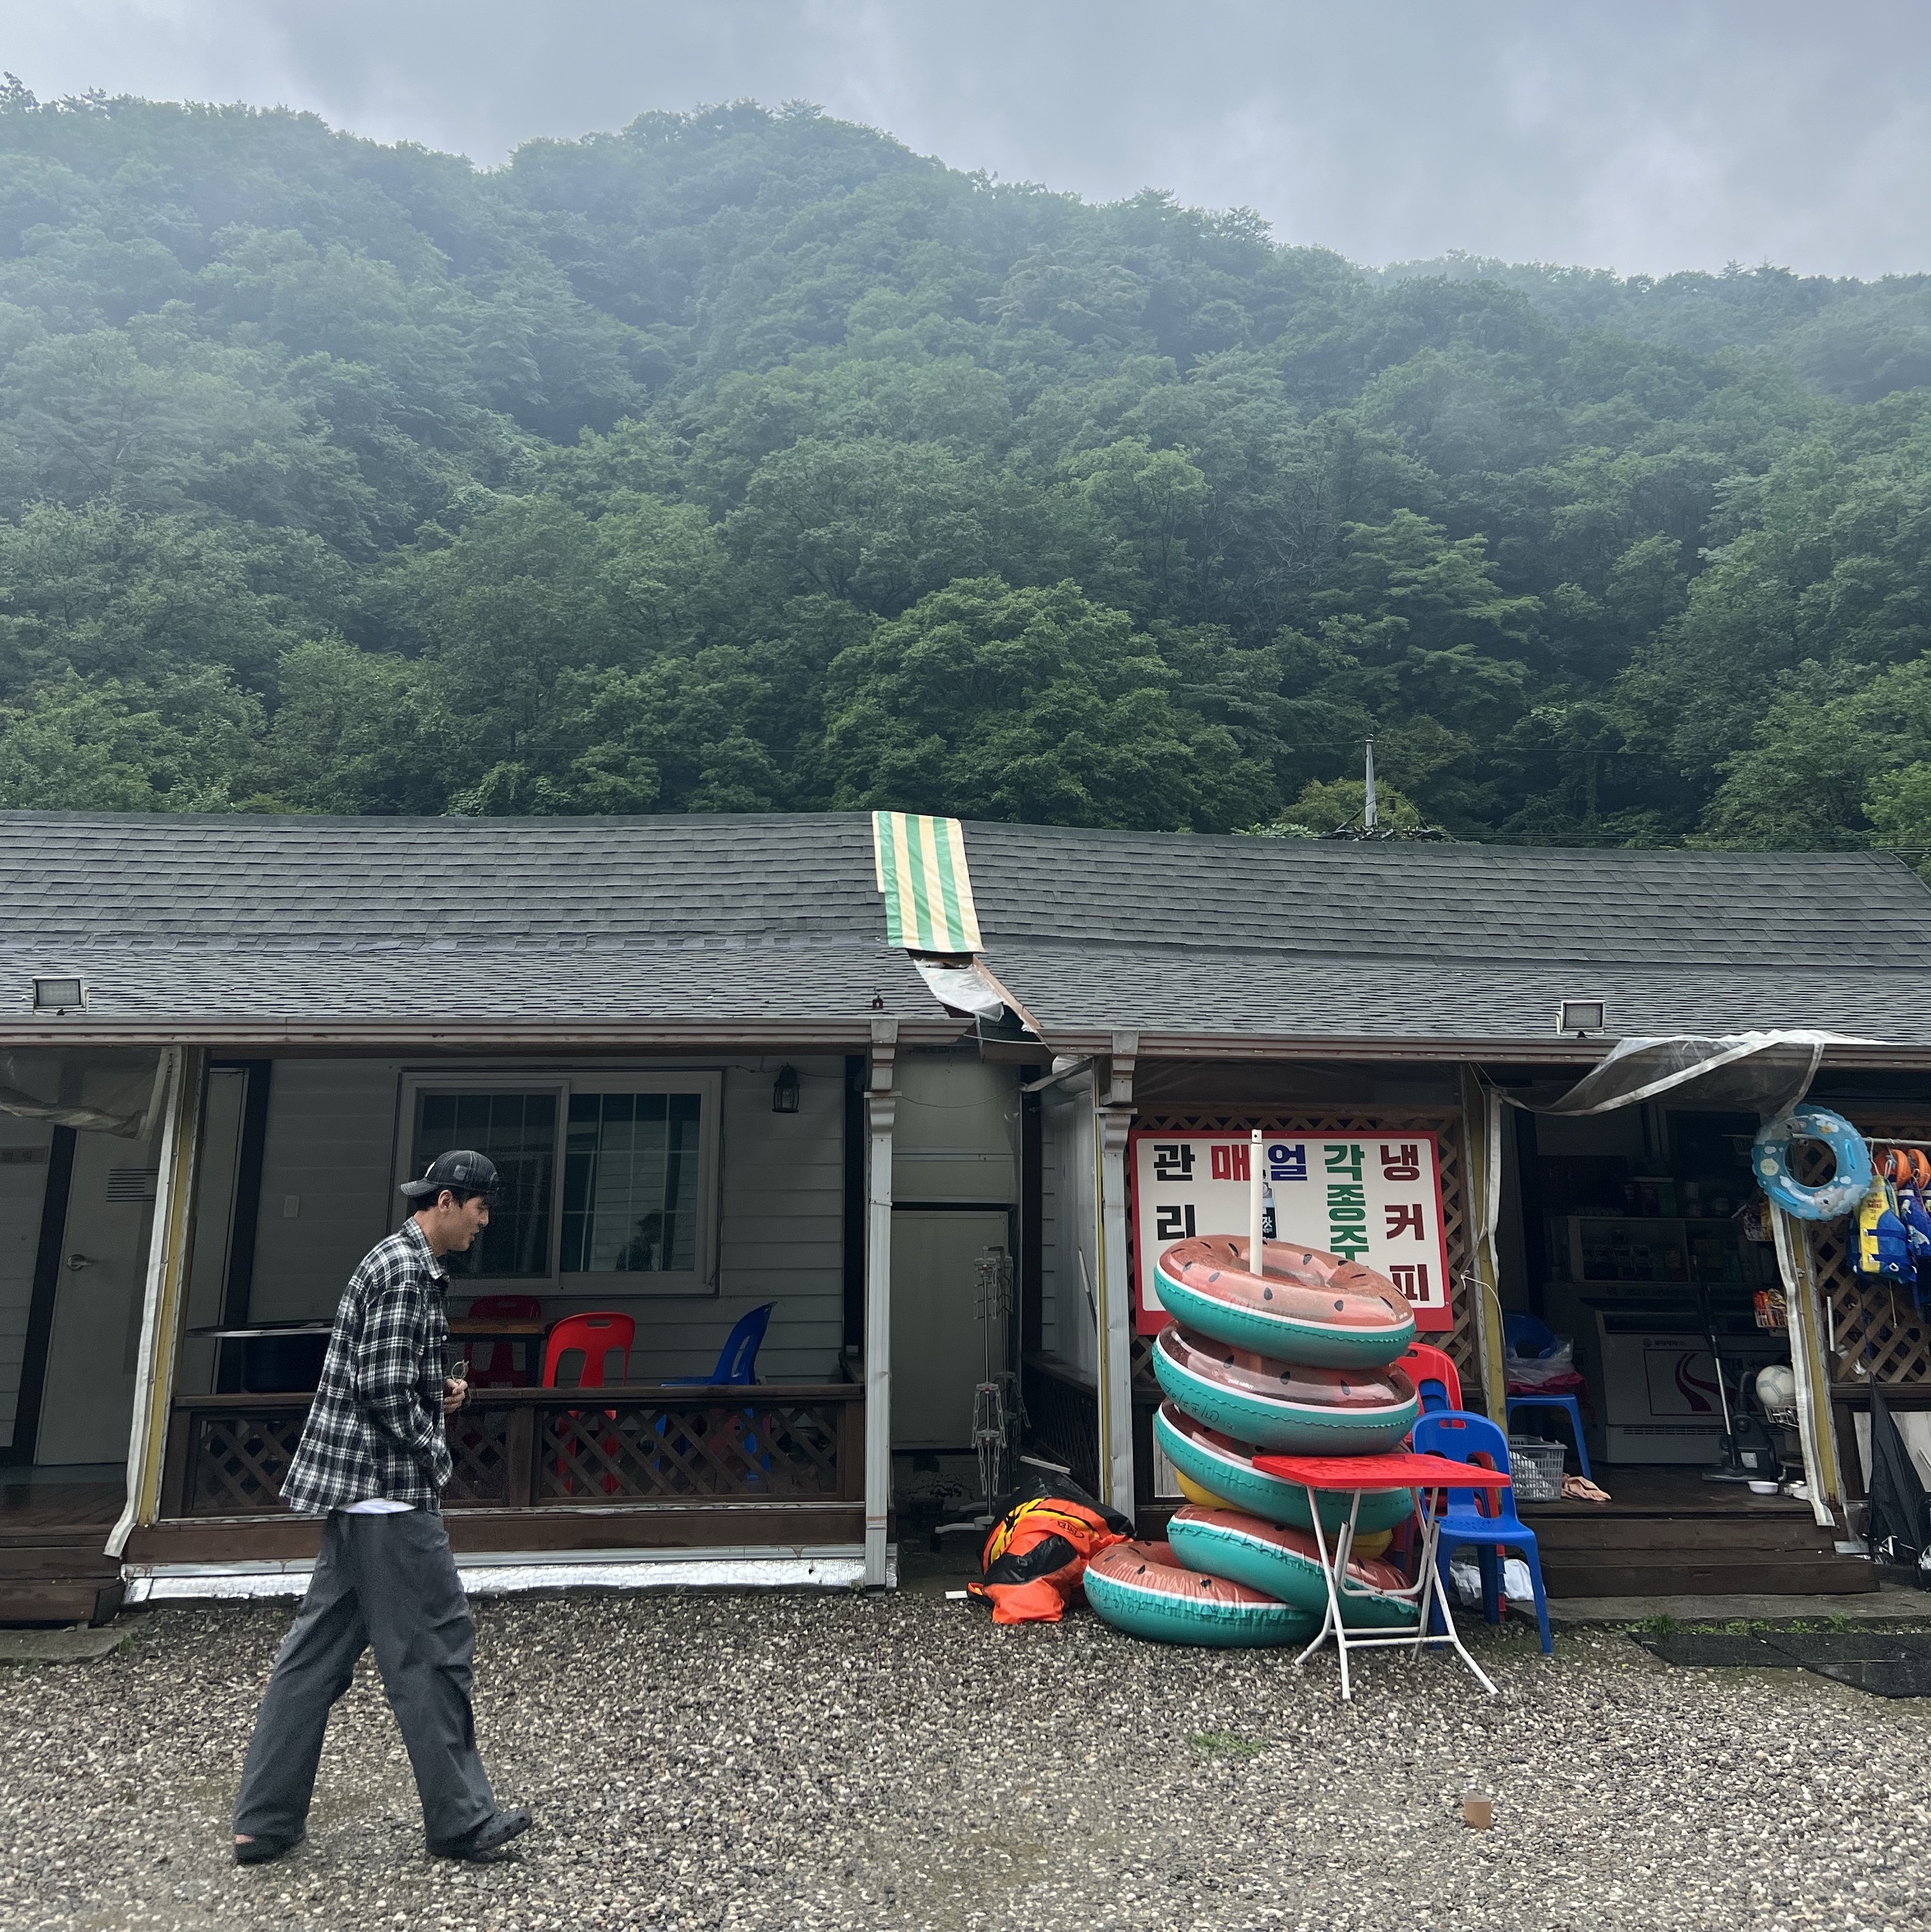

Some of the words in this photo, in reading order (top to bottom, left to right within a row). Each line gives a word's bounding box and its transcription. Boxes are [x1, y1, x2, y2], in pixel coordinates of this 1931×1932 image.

[1211, 1144, 1251, 1181] 매
[1268, 1144, 1308, 1181] 얼
[1324, 1144, 1370, 1268] 각종주
[1380, 1144, 1430, 1301] 냉커피
